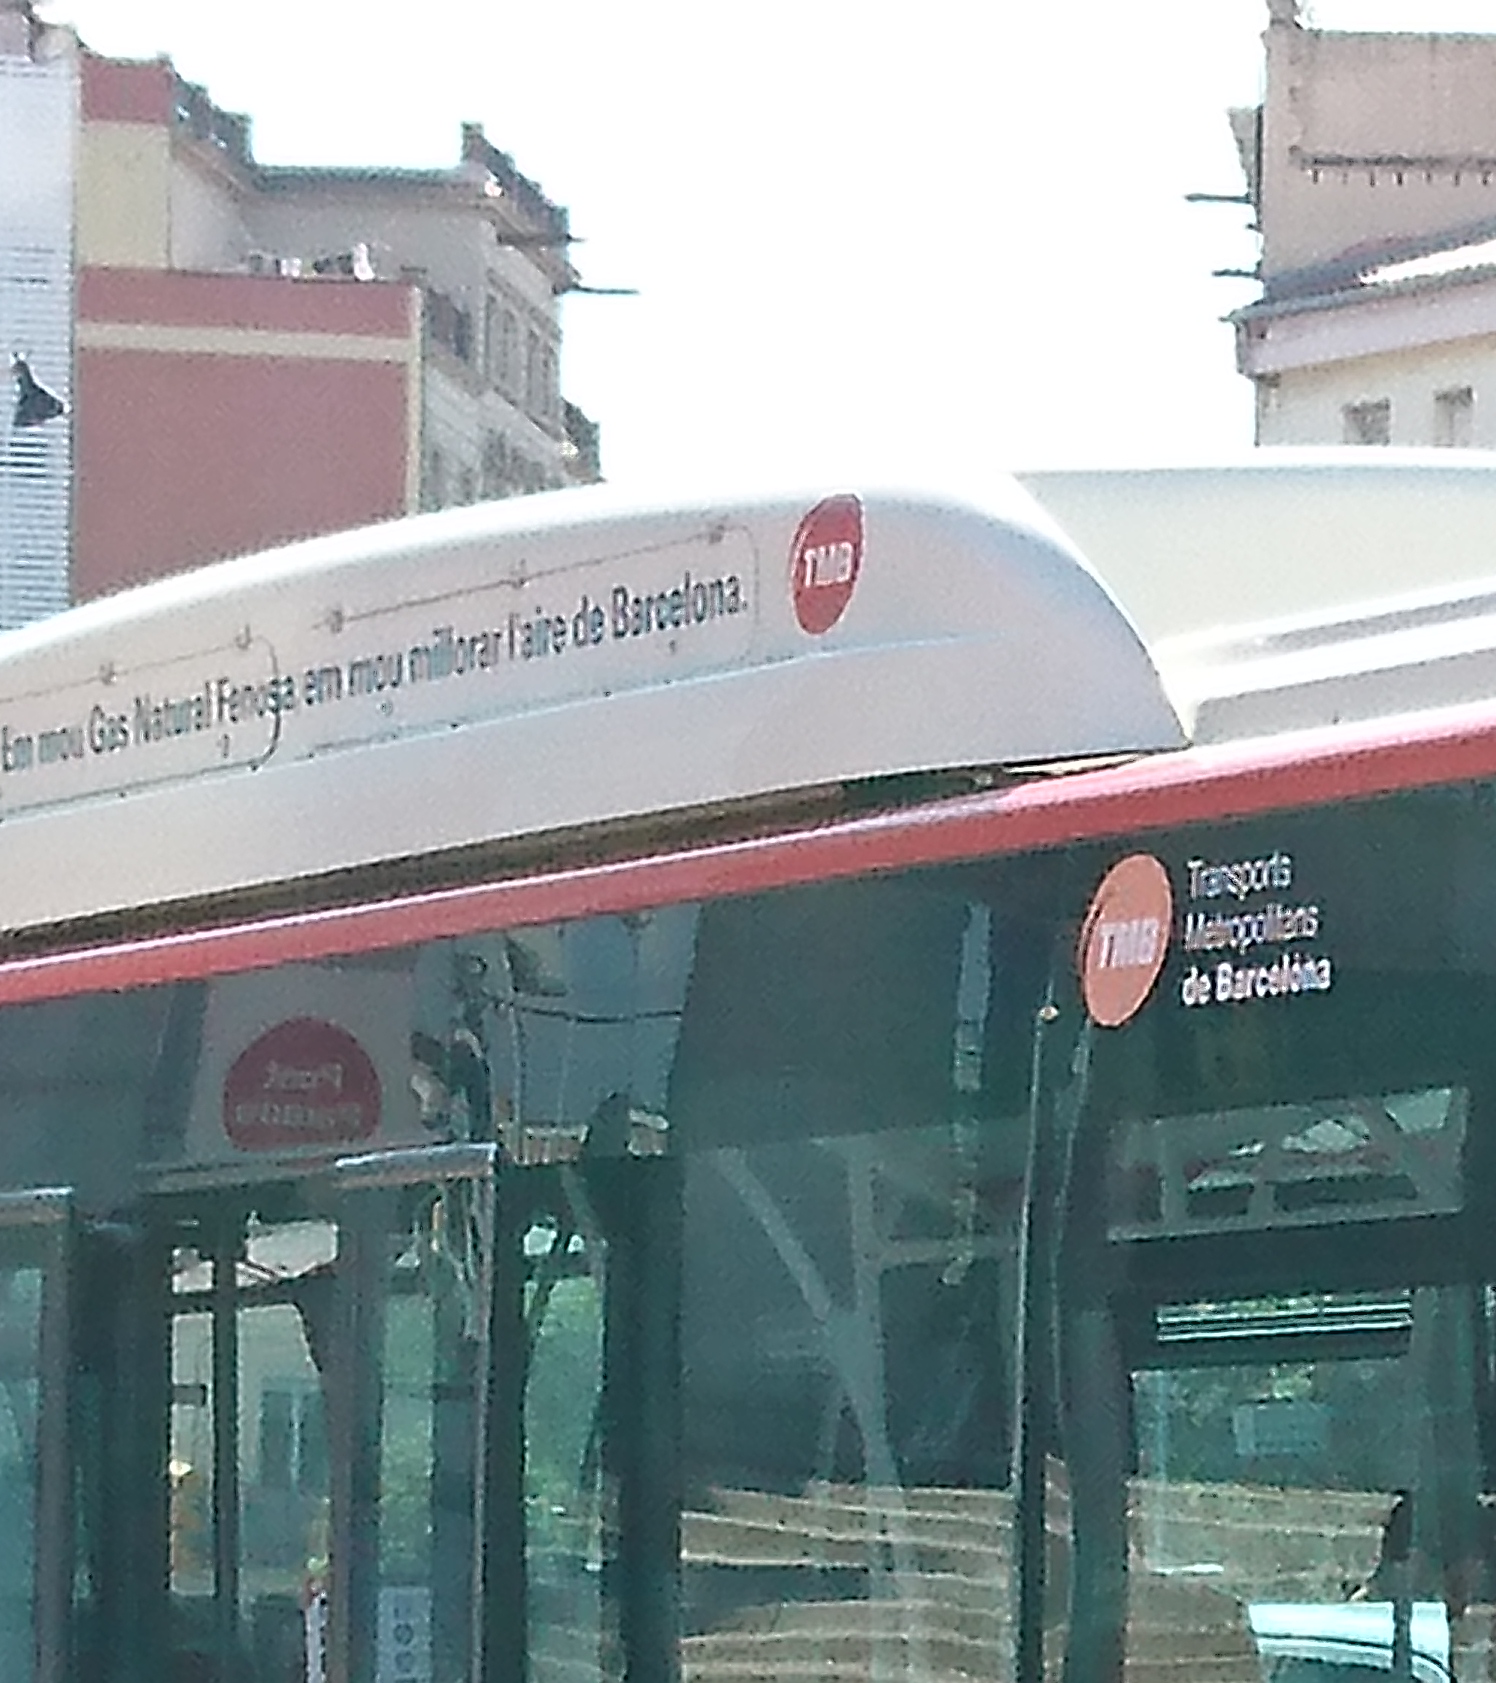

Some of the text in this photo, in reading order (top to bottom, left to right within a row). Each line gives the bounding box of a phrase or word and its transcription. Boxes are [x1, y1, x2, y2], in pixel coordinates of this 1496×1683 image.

[804, 541, 853, 588] TMB
[1, 723, 33, 771] Em
[89, 703, 129, 755] Gas
[133, 678, 211, 746] Natural
[216, 675, 296, 722] Fenosa
[305, 666, 342, 706] em
[348, 652, 403, 697] mou
[408, 623, 502, 683] millorar
[572, 594, 605, 648] de
[1186, 850, 1293, 901] Transports
[1098, 914, 1160, 969] TMB
[1185, 903, 1320, 955] Metropolitans
[1182, 952, 1332, 1006] de Barcelona
